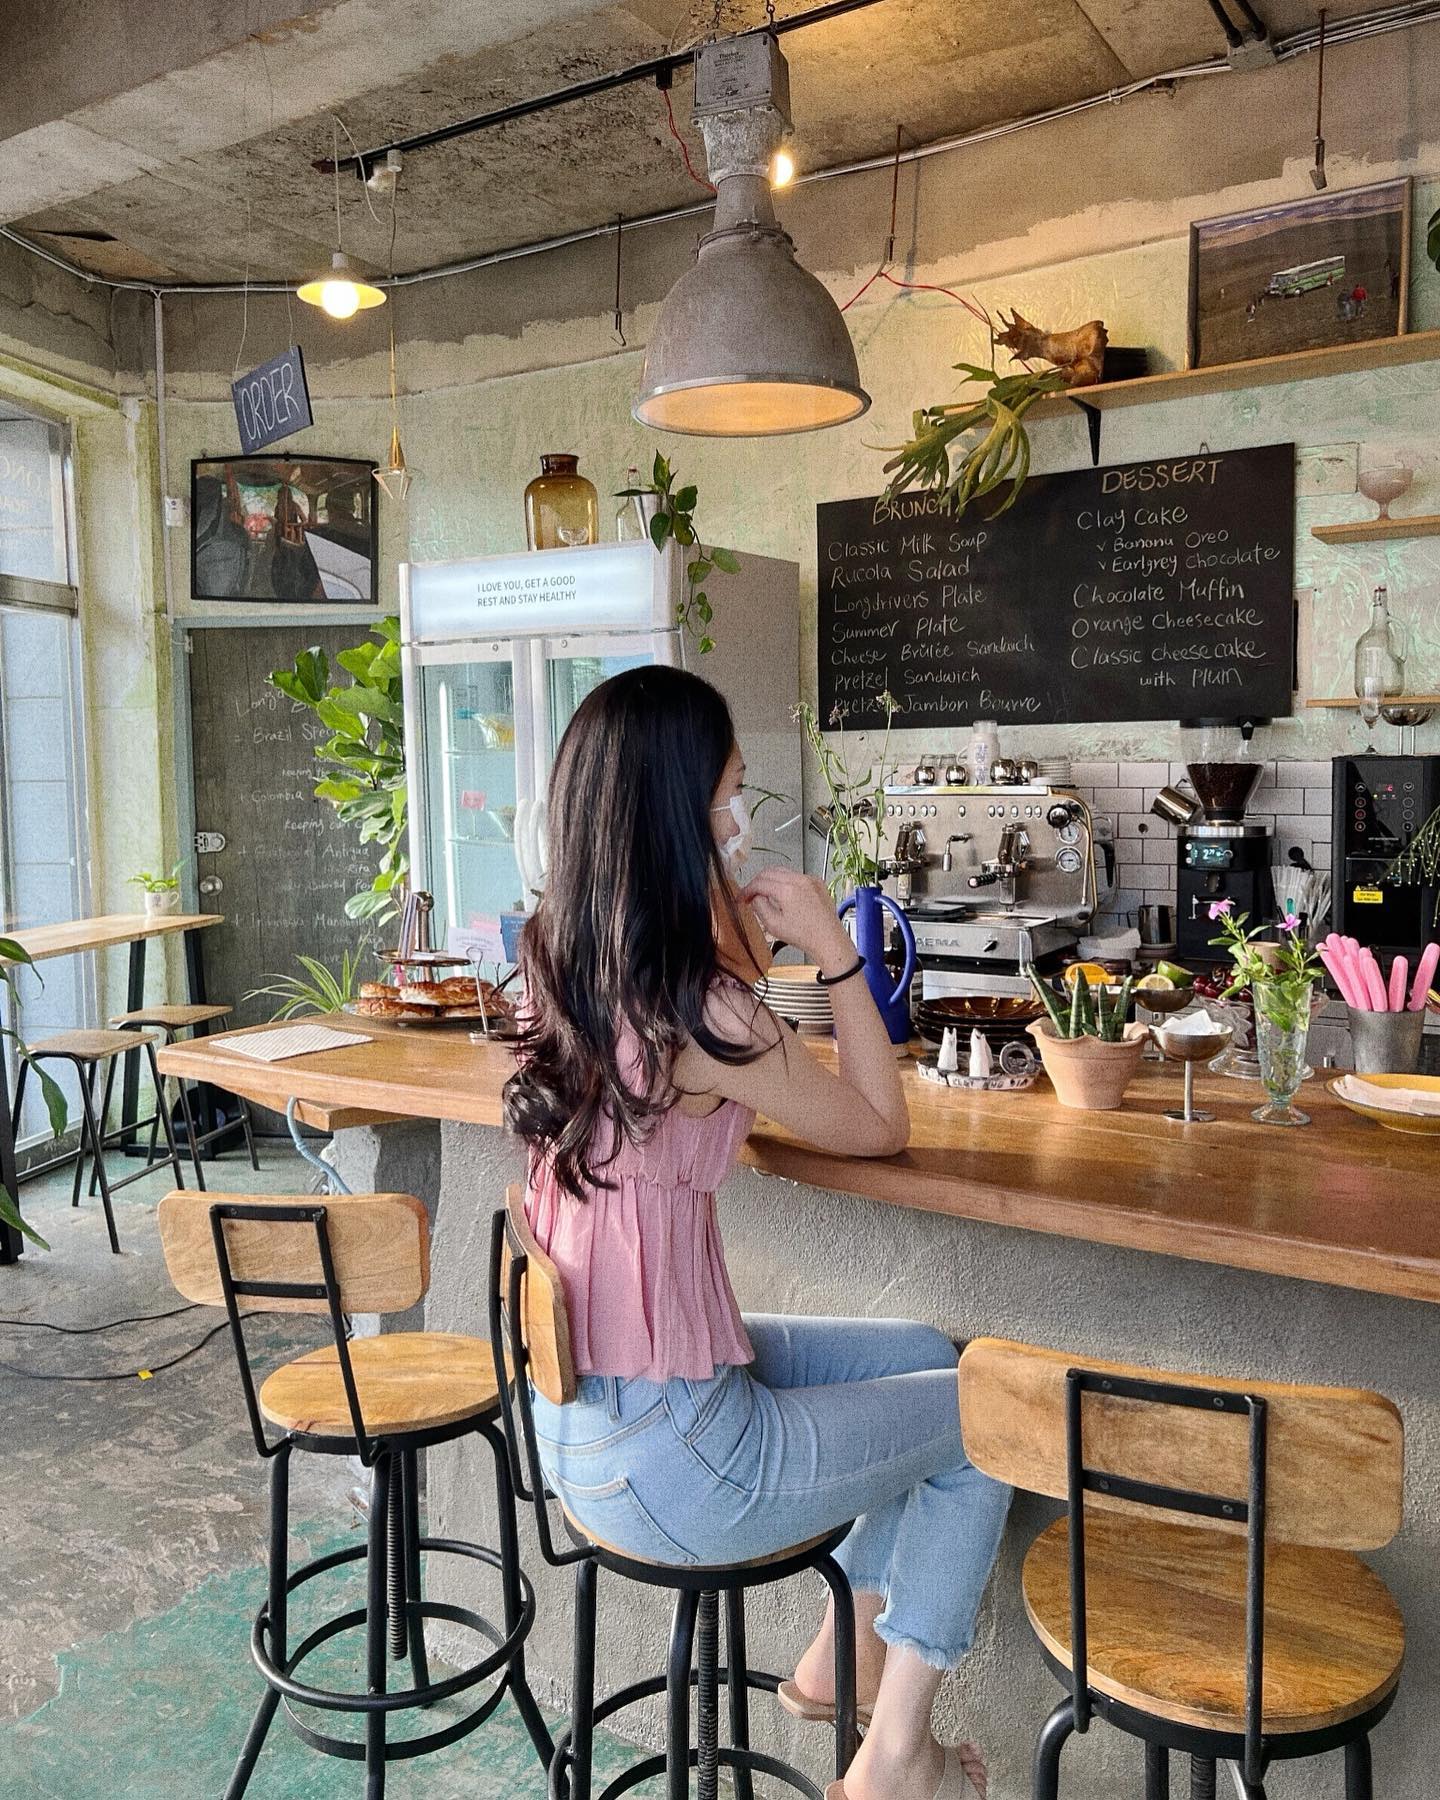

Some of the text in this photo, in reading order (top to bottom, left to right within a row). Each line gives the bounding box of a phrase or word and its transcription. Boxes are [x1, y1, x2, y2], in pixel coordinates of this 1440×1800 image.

[242, 362, 300, 440] ORDER
[1101, 459, 1223, 494] DESSERT
[873, 495, 952, 526] BRUNCH
[1077, 506, 1188, 533] Clay Cake
[828, 531, 987, 562] Classic Milk Soup
[1185, 529, 1229, 549] Oreo
[831, 555, 970, 589] Rucola Salad
[1112, 554, 1177, 578] Earlgrey
[477, 576, 576, 593] I LOVE YOU, GET A GOOD
[1073, 577, 1245, 608] Chocolate Muffin
[478, 590, 577, 607] REST AND STAY HEALTHY
[834, 584, 987, 620] Longdrivers Plate
[832, 616, 966, 643] Summer Plate
[1072, 615, 1145, 638] Orange
[831, 650, 887, 666] Cheese
[1071, 646, 1142, 669] Classic
[903, 667, 981, 685] Sandwich
[1139, 670, 1176, 687] with
[901, 693, 968, 714] Jambon
[252, 725, 293, 744] Brazil
[915, 937, 961, 948] AEMA
